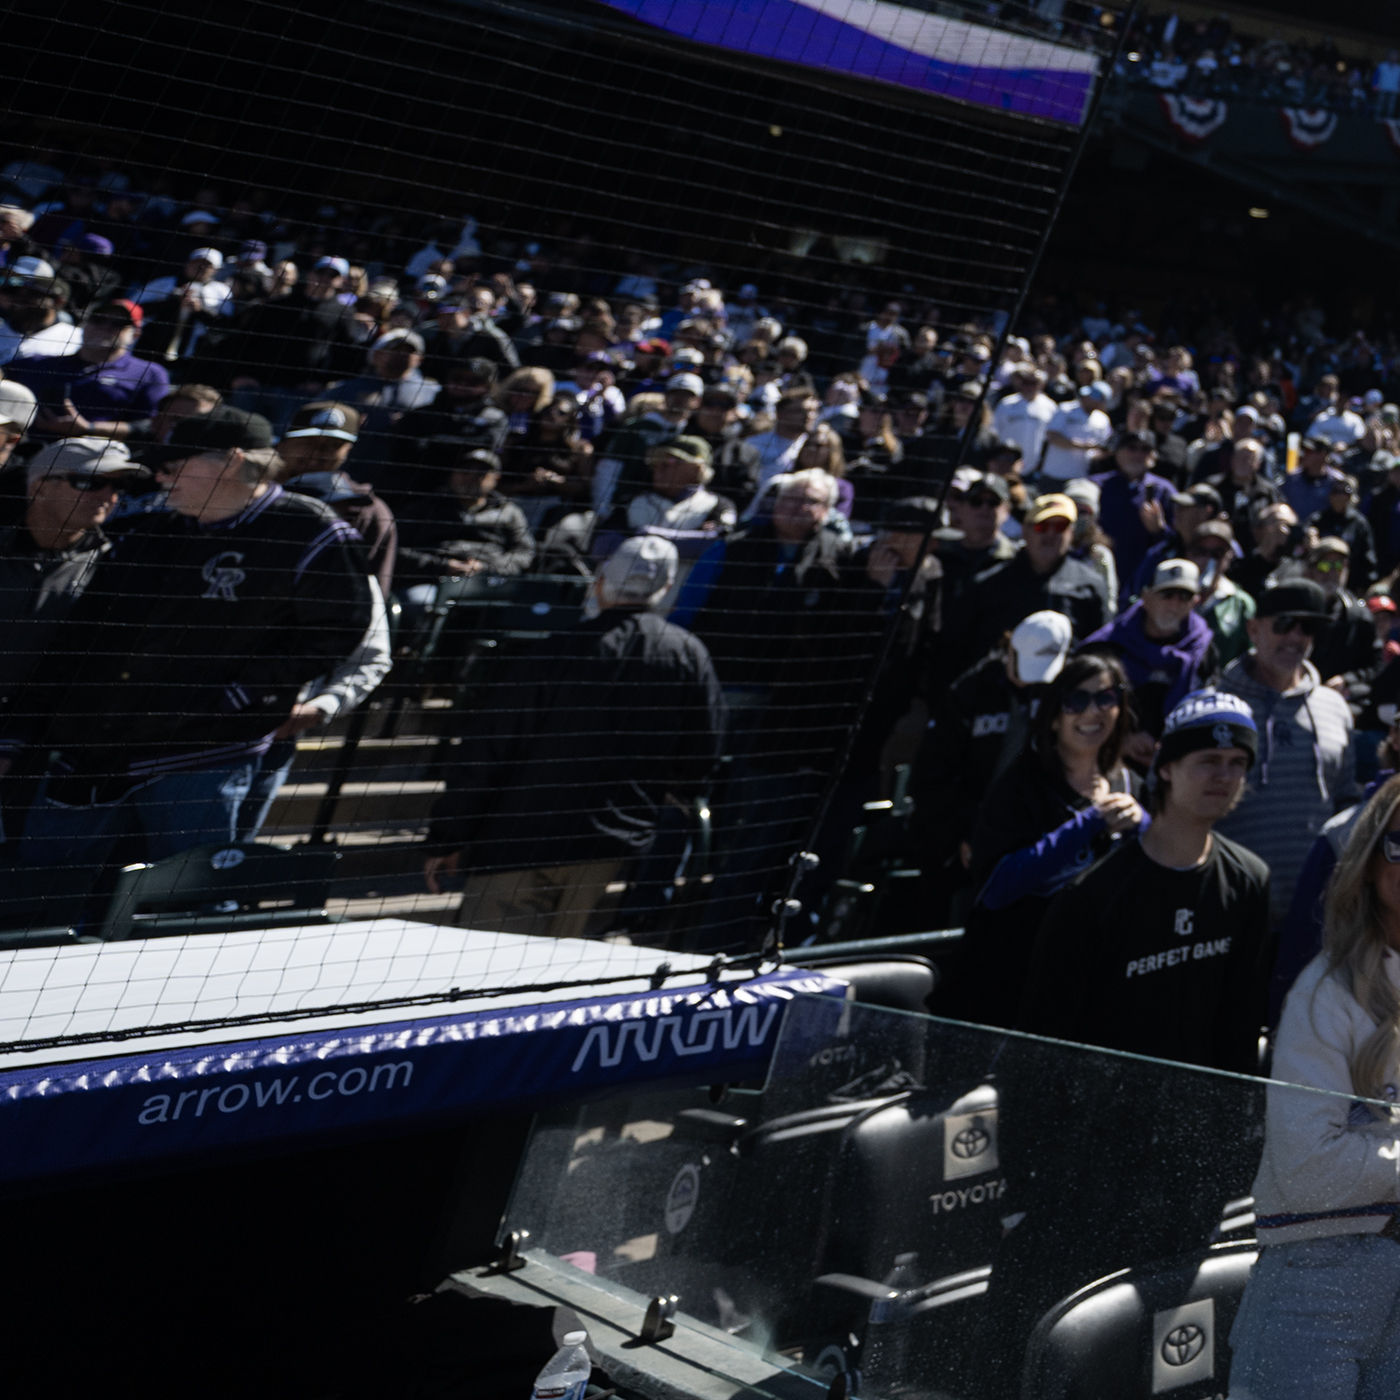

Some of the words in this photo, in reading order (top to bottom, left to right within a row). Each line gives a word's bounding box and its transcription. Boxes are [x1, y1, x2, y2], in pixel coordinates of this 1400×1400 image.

[1126, 945, 1191, 979] PERFECT
[1192, 936, 1232, 960] GAME
[571, 1002, 778, 1073] ARROW
[137, 1059, 414, 1125] arrow.com
